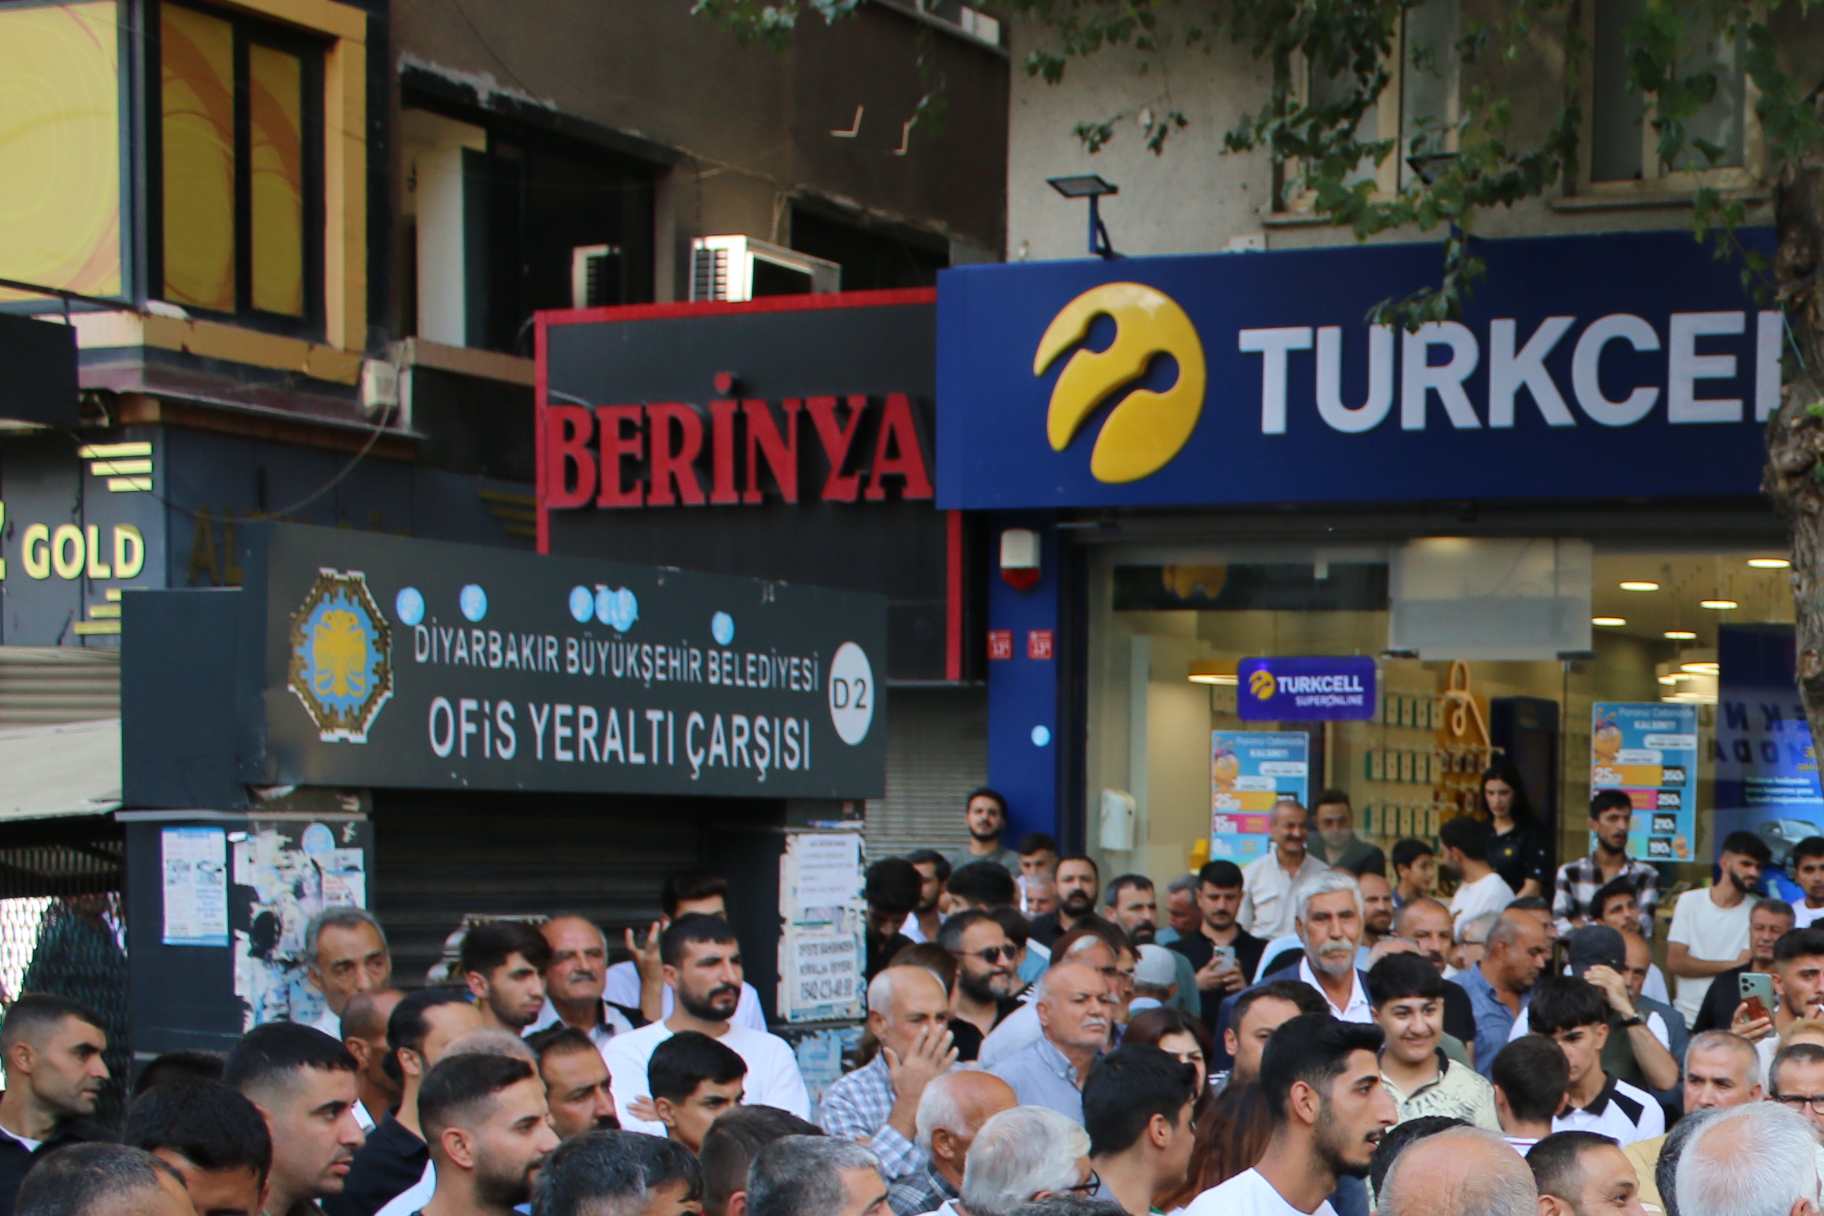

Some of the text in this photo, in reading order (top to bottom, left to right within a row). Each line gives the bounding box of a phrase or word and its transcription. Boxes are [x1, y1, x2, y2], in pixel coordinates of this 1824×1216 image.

[543, 372, 933, 508] BERİNYA
[22, 523, 145, 580] GOLD
[415, 616, 818, 692] DİYARBAKIR BÜYÜKŞEHİR BELEDİYESİ
[1276, 675, 1364, 694] TURKCELL
[1295, 693, 1364, 707] SUPERONLINE
[528, 702, 675, 767] YERALTI
[685, 711, 810, 782] ÇARŞISI
